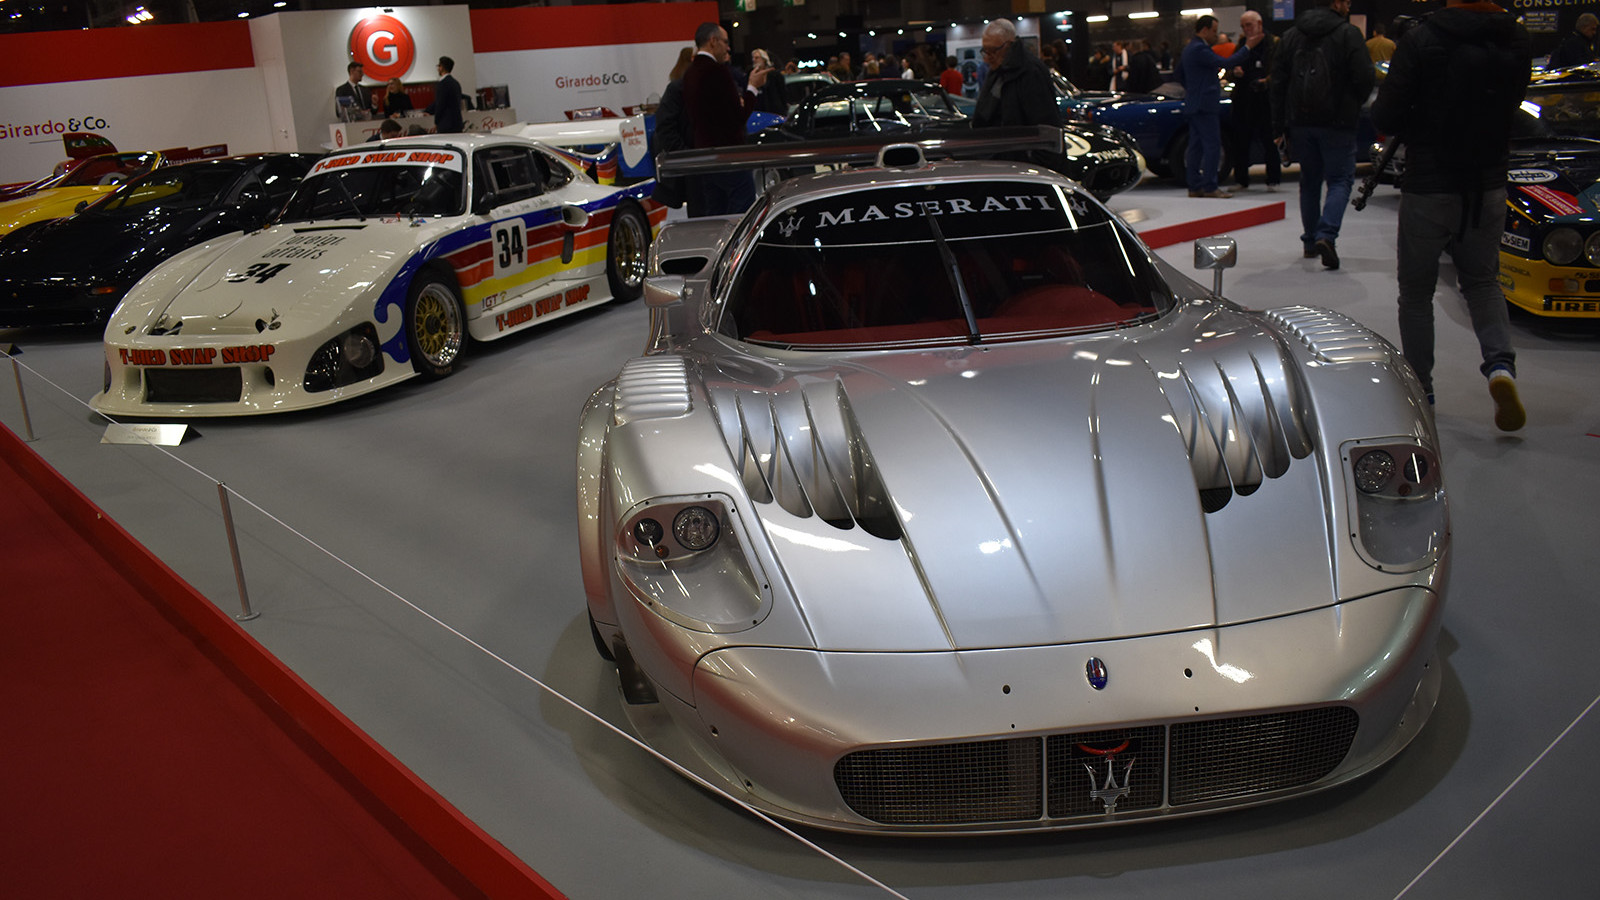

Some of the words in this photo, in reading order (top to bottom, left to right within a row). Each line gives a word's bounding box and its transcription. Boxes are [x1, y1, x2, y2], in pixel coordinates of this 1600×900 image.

[366, 30, 399, 67] G
[555, 74, 601, 89] Girardo
[361, 152, 407, 164] SWAP
[407, 152, 454, 164] SHOP
[815, 195, 1056, 228] MASERATI
[261, 246, 328, 260] affairs
[496, 225, 524, 269] 34
[228, 263, 292, 284] 34
[535, 293, 563, 318] SWAP
[564, 284, 590, 307] SHOP
[119, 348, 166, 365] T-BIRD
[169, 347, 217, 365] SWAP
[221, 344, 276, 364] SHOP
